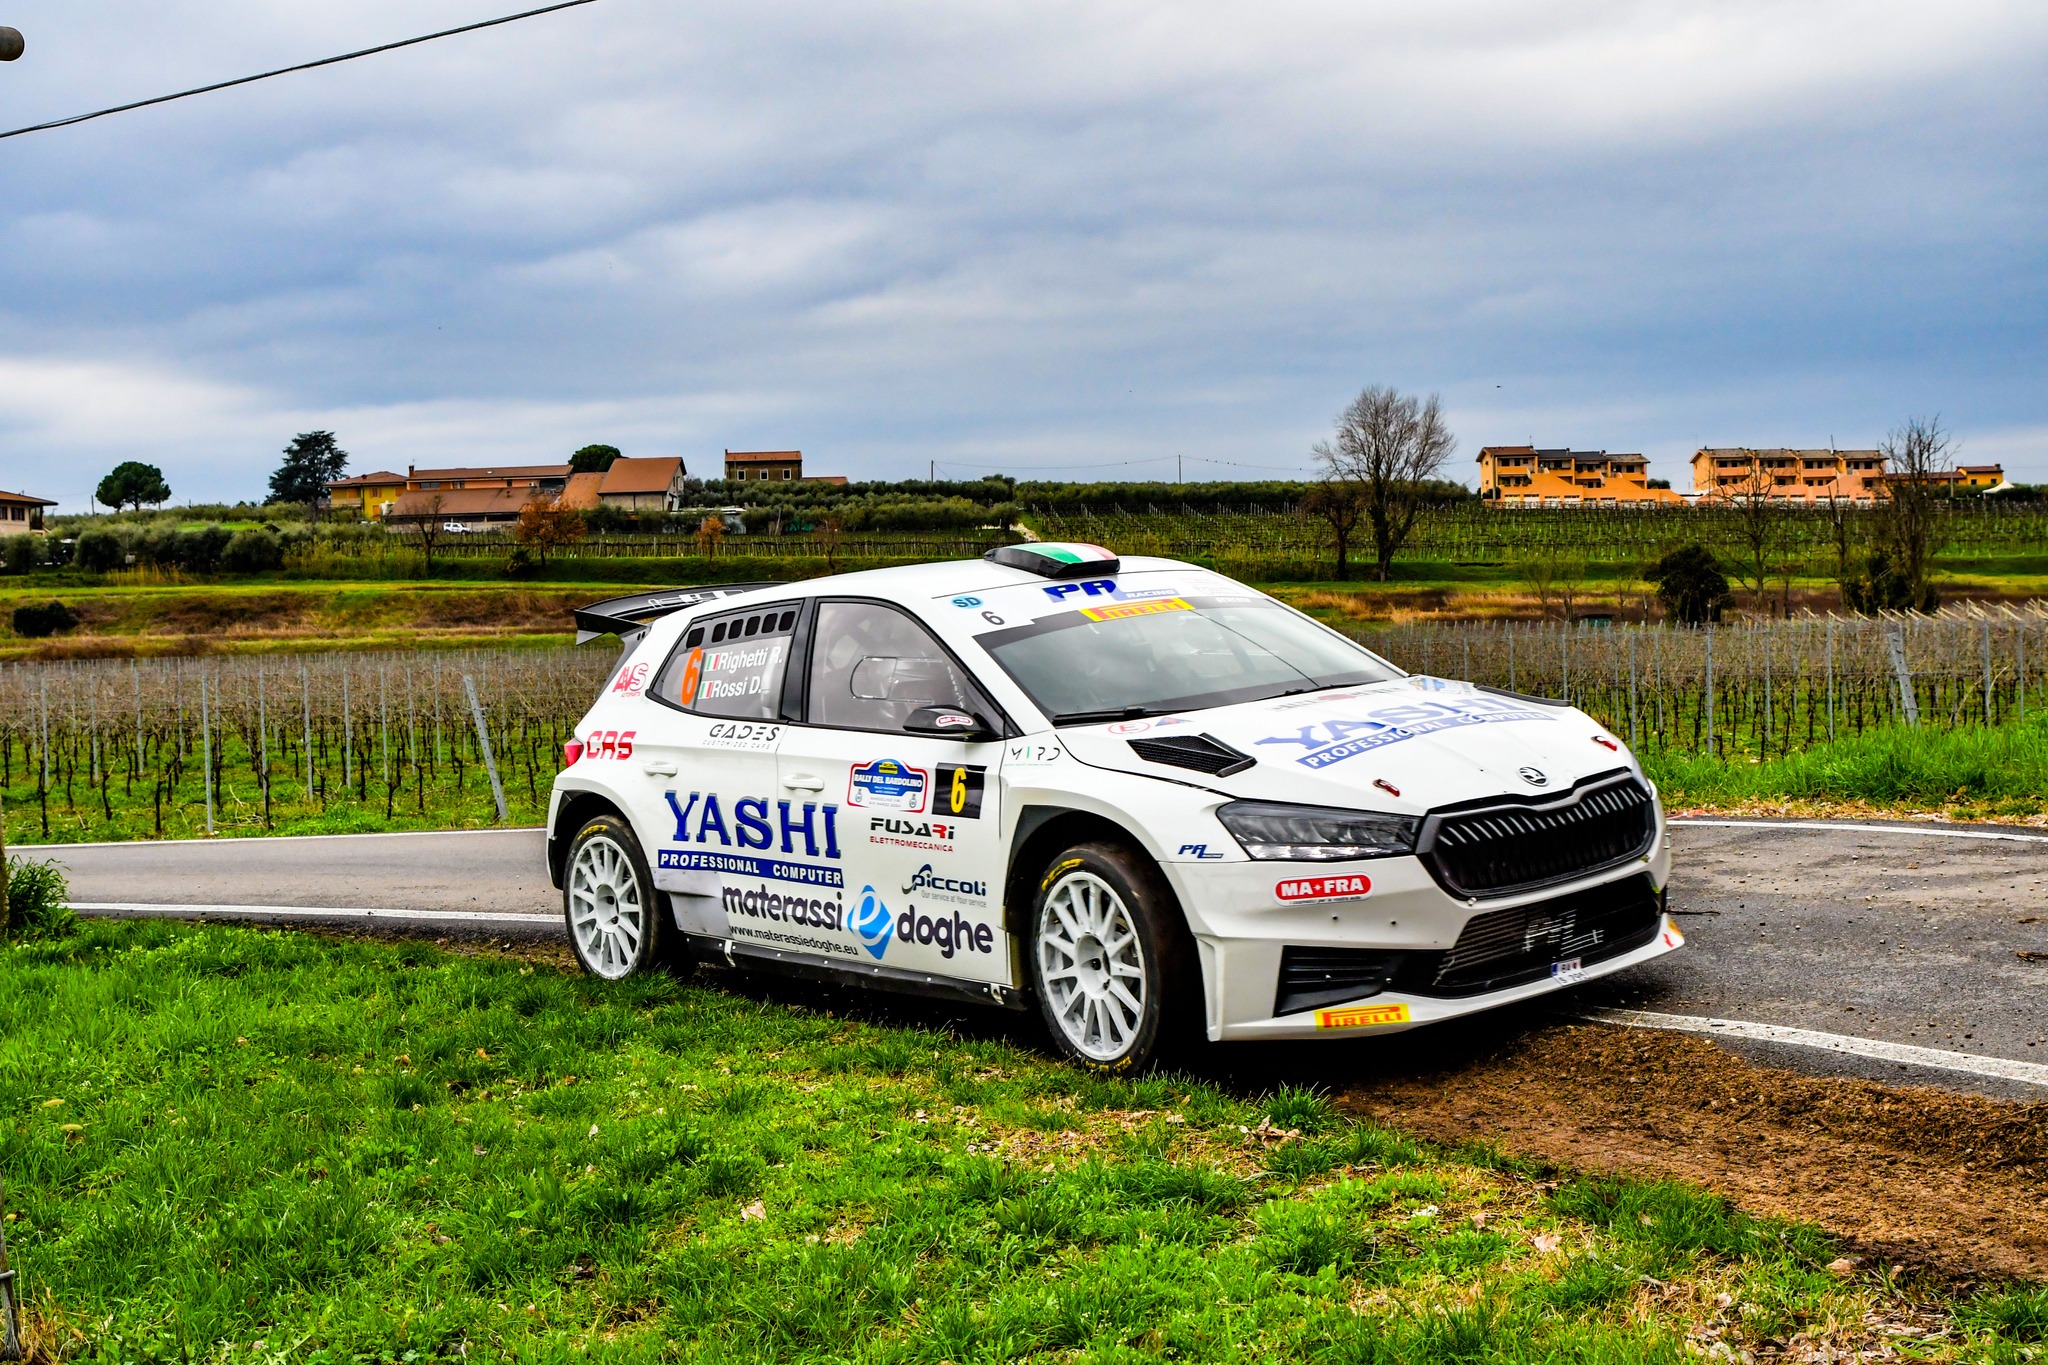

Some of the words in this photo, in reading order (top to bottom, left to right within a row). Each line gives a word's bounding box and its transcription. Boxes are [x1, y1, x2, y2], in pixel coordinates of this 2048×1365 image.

[952, 596, 981, 608] SD
[1042, 580, 1116, 603] PA
[1126, 590, 1175, 599] RACING
[981, 610, 1005, 626] 6
[1087, 598, 1182, 620] PIRELLI
[717, 650, 766, 674] Righetti
[769, 645, 783, 664] R.
[680, 647, 703, 705] 6
[710, 682, 746, 699] Rossi
[749, 676, 763, 694] D.
[1254, 698, 1528, 750] YASHI
[586, 730, 637, 760] CRS
[1304, 719, 1450, 767] PROFESSIONAL
[1457, 712, 1549, 725] COMPUTER
[854, 774, 872, 782] RALLY
[872, 776, 884, 784] DEL
[885, 776, 923, 787] BARDOLINO
[951, 767, 967, 813] 6
[665, 789, 842, 859] YASHI
[869, 836, 954, 852] ELETTROMECCANICA
[660, 853, 760, 874] PROFESSIONAL
[772, 864, 842, 885] COMPUTER
[911, 873, 986, 897] piccoli
[722, 883, 843, 932] materassi
[897, 904, 994, 959] doghe
[729, 924, 859, 956] www.materassiedoghe.eu
[1322, 1006, 1403, 1029] PIRELLI
